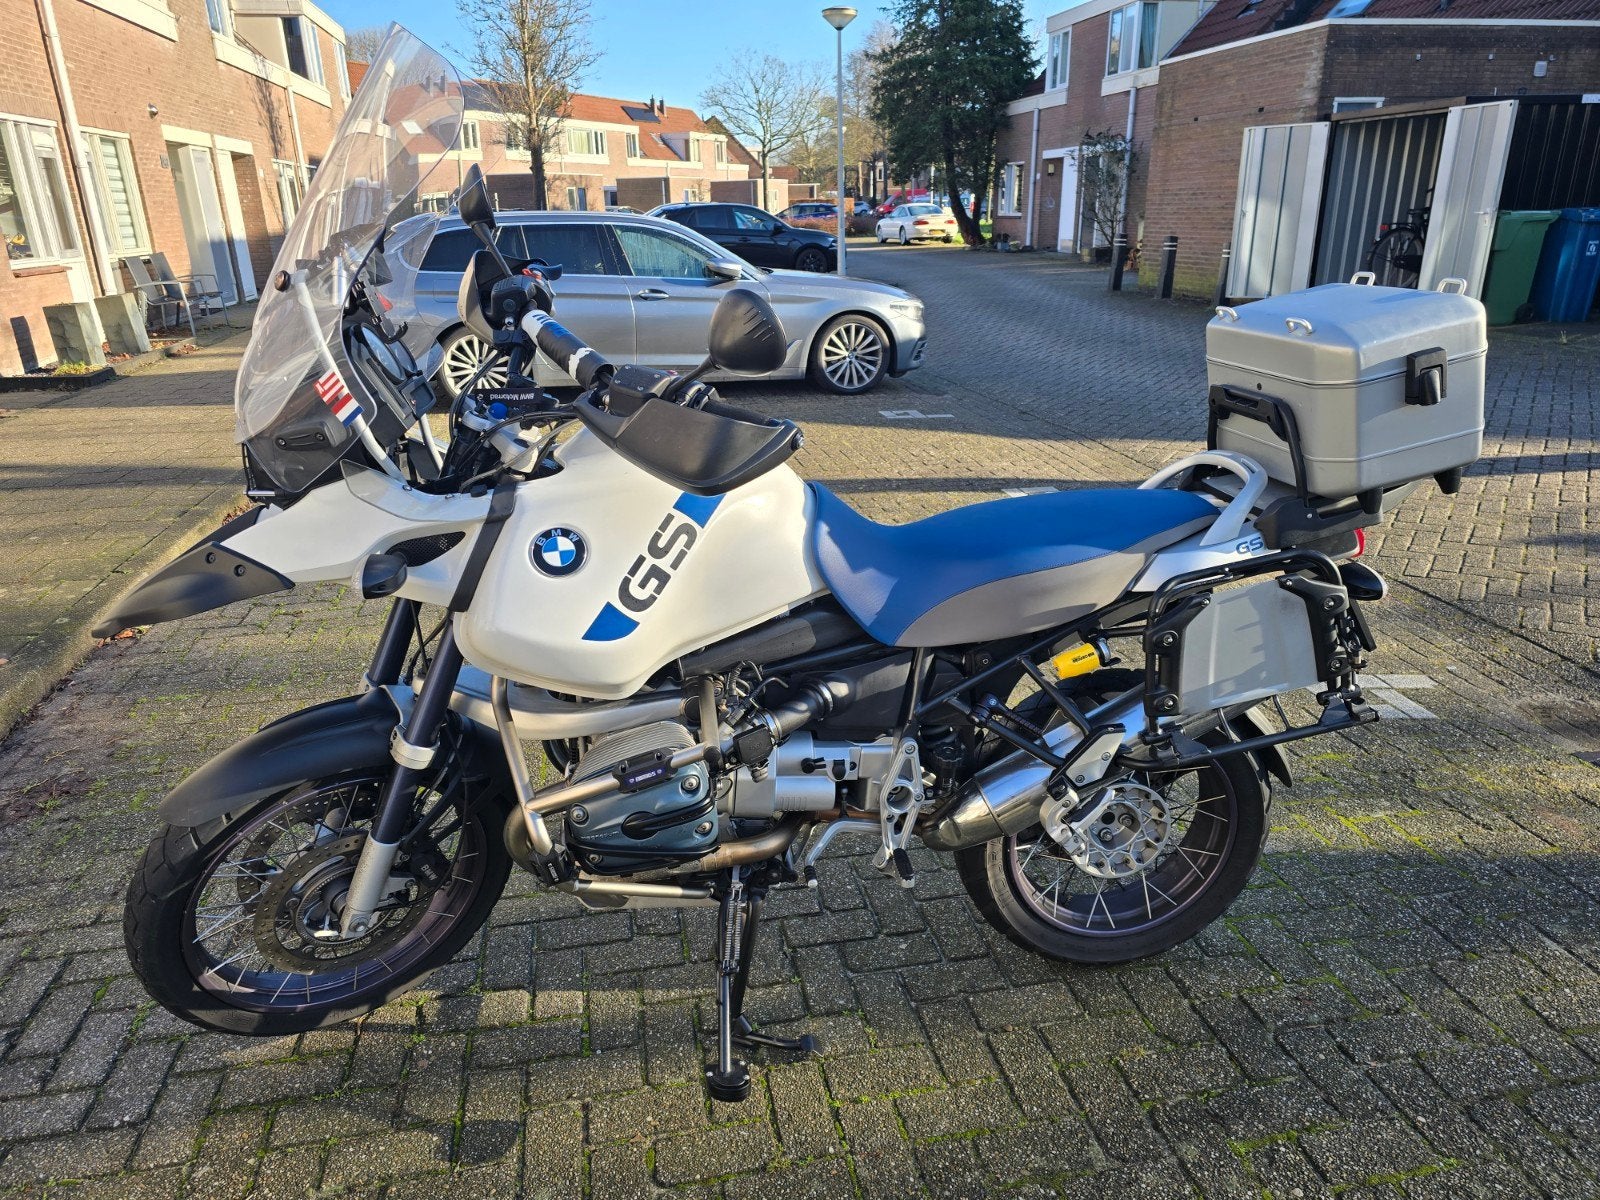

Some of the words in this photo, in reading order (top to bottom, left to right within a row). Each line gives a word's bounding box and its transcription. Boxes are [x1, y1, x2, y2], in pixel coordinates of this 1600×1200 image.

[490, 393, 519, 401] Motorrad
[535, 529, 580, 546] BMW
[1235, 536, 1264, 555] GS
[618, 512, 698, 613] GS
[421, 864, 438, 881] BMW
